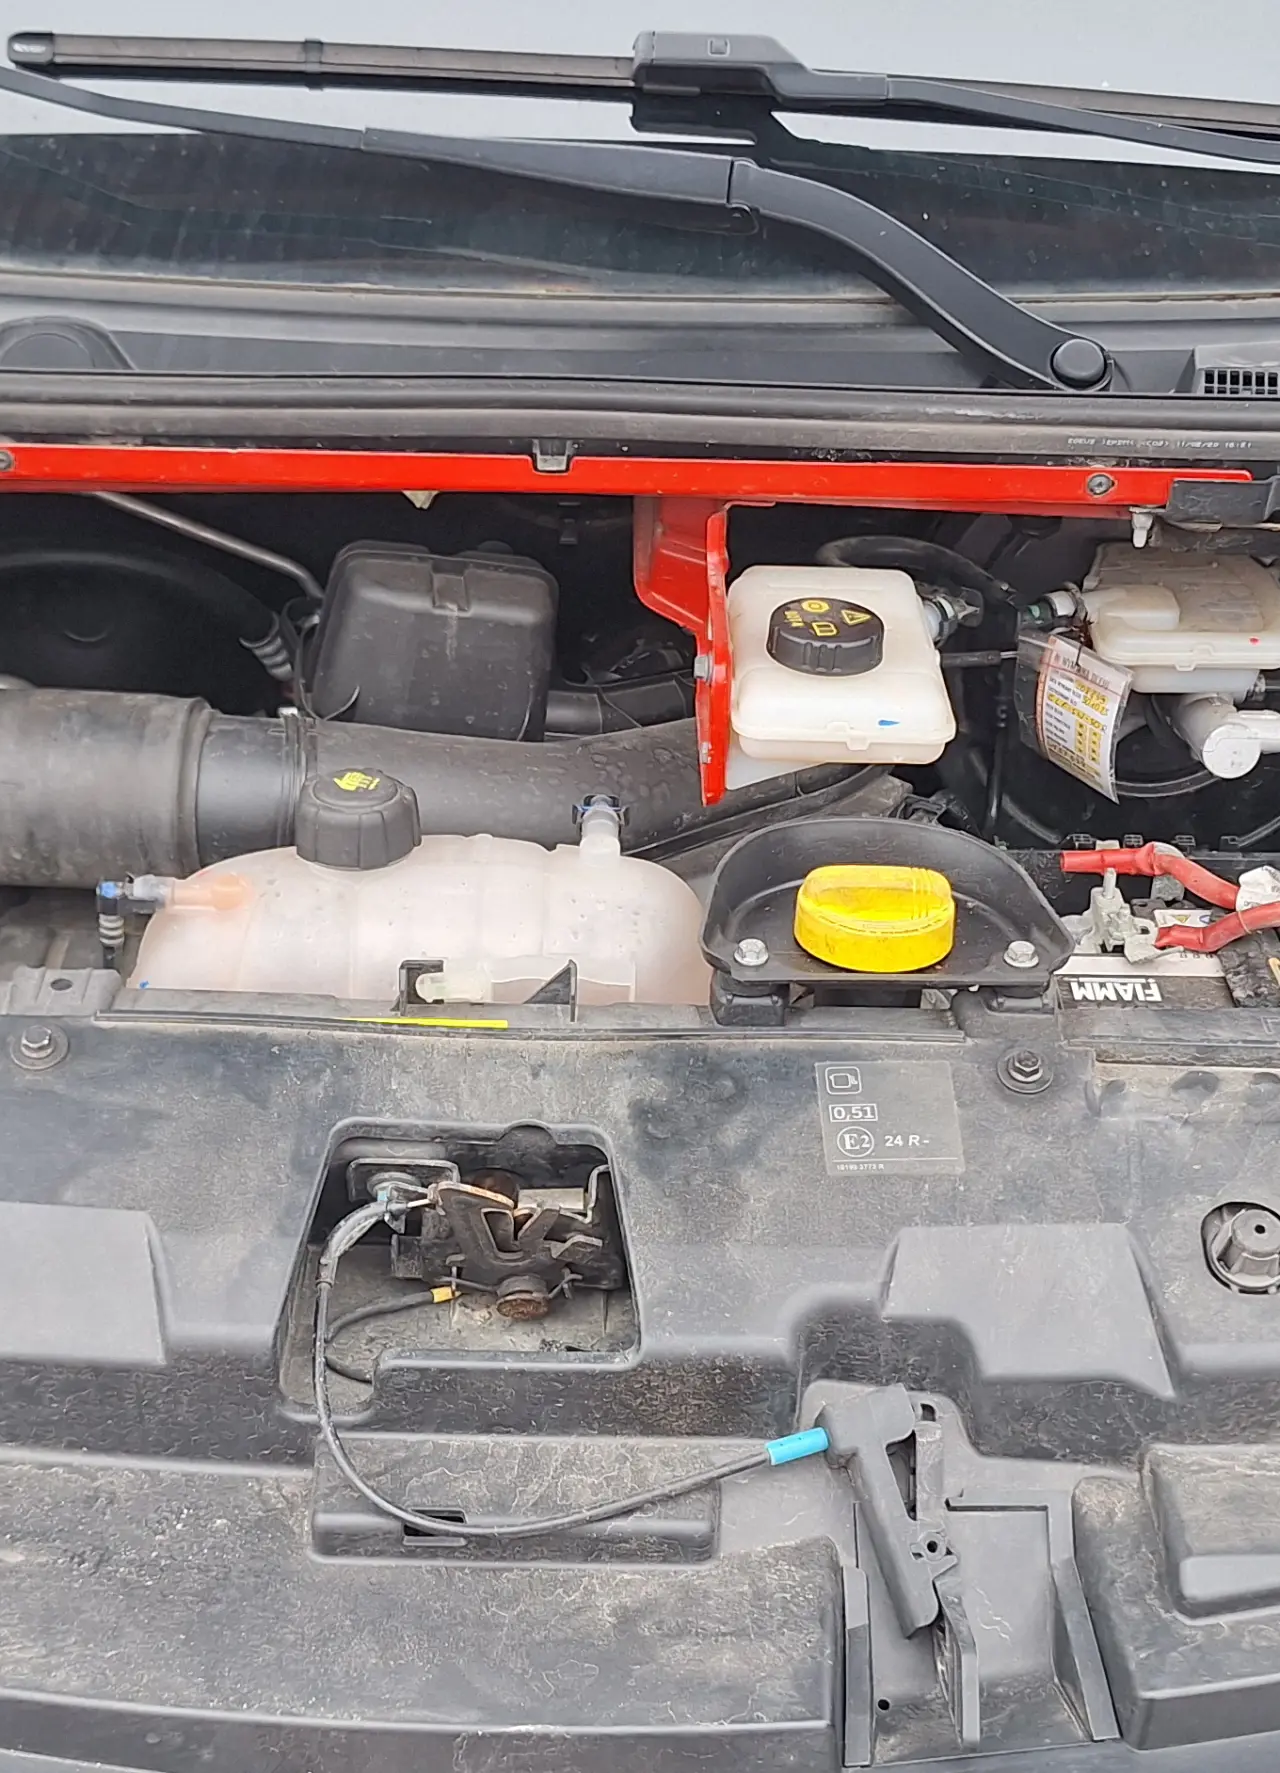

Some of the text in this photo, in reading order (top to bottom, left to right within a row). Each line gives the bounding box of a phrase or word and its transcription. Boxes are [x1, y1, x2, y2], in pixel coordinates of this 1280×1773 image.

[1070, 981, 1162, 1002] FIAMM
[833, 1106, 874, 1120] 0,51
[842, 1133, 871, 1150] E2
[884, 1135, 904, 1147] 24
